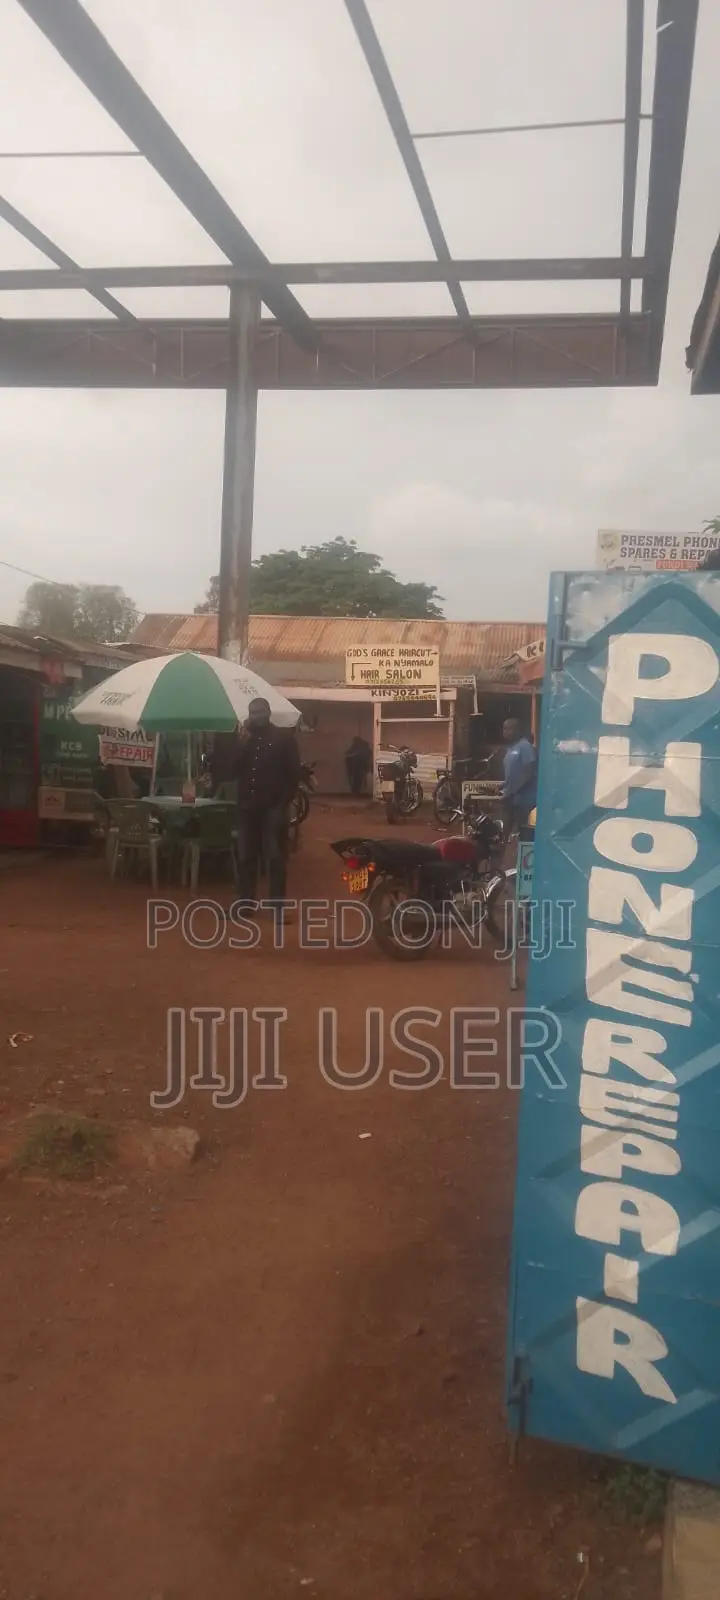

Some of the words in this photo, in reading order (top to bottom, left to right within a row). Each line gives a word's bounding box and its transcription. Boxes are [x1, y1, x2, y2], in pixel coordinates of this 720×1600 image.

[620, 535, 680, 547] PRESMEL
[683, 536, 720, 549] PHON
[620, 547, 666, 559] SPARES
[669, 549, 677, 560] &
[346, 648, 368, 657] GOD'S
[371, 648, 394, 657] GRACE
[398, 648, 431, 657] HAIRCUT
[360, 669, 380, 680] HAIR
[385, 669, 422, 679] SALON
[370, 689, 420, 697] KINYOZI
